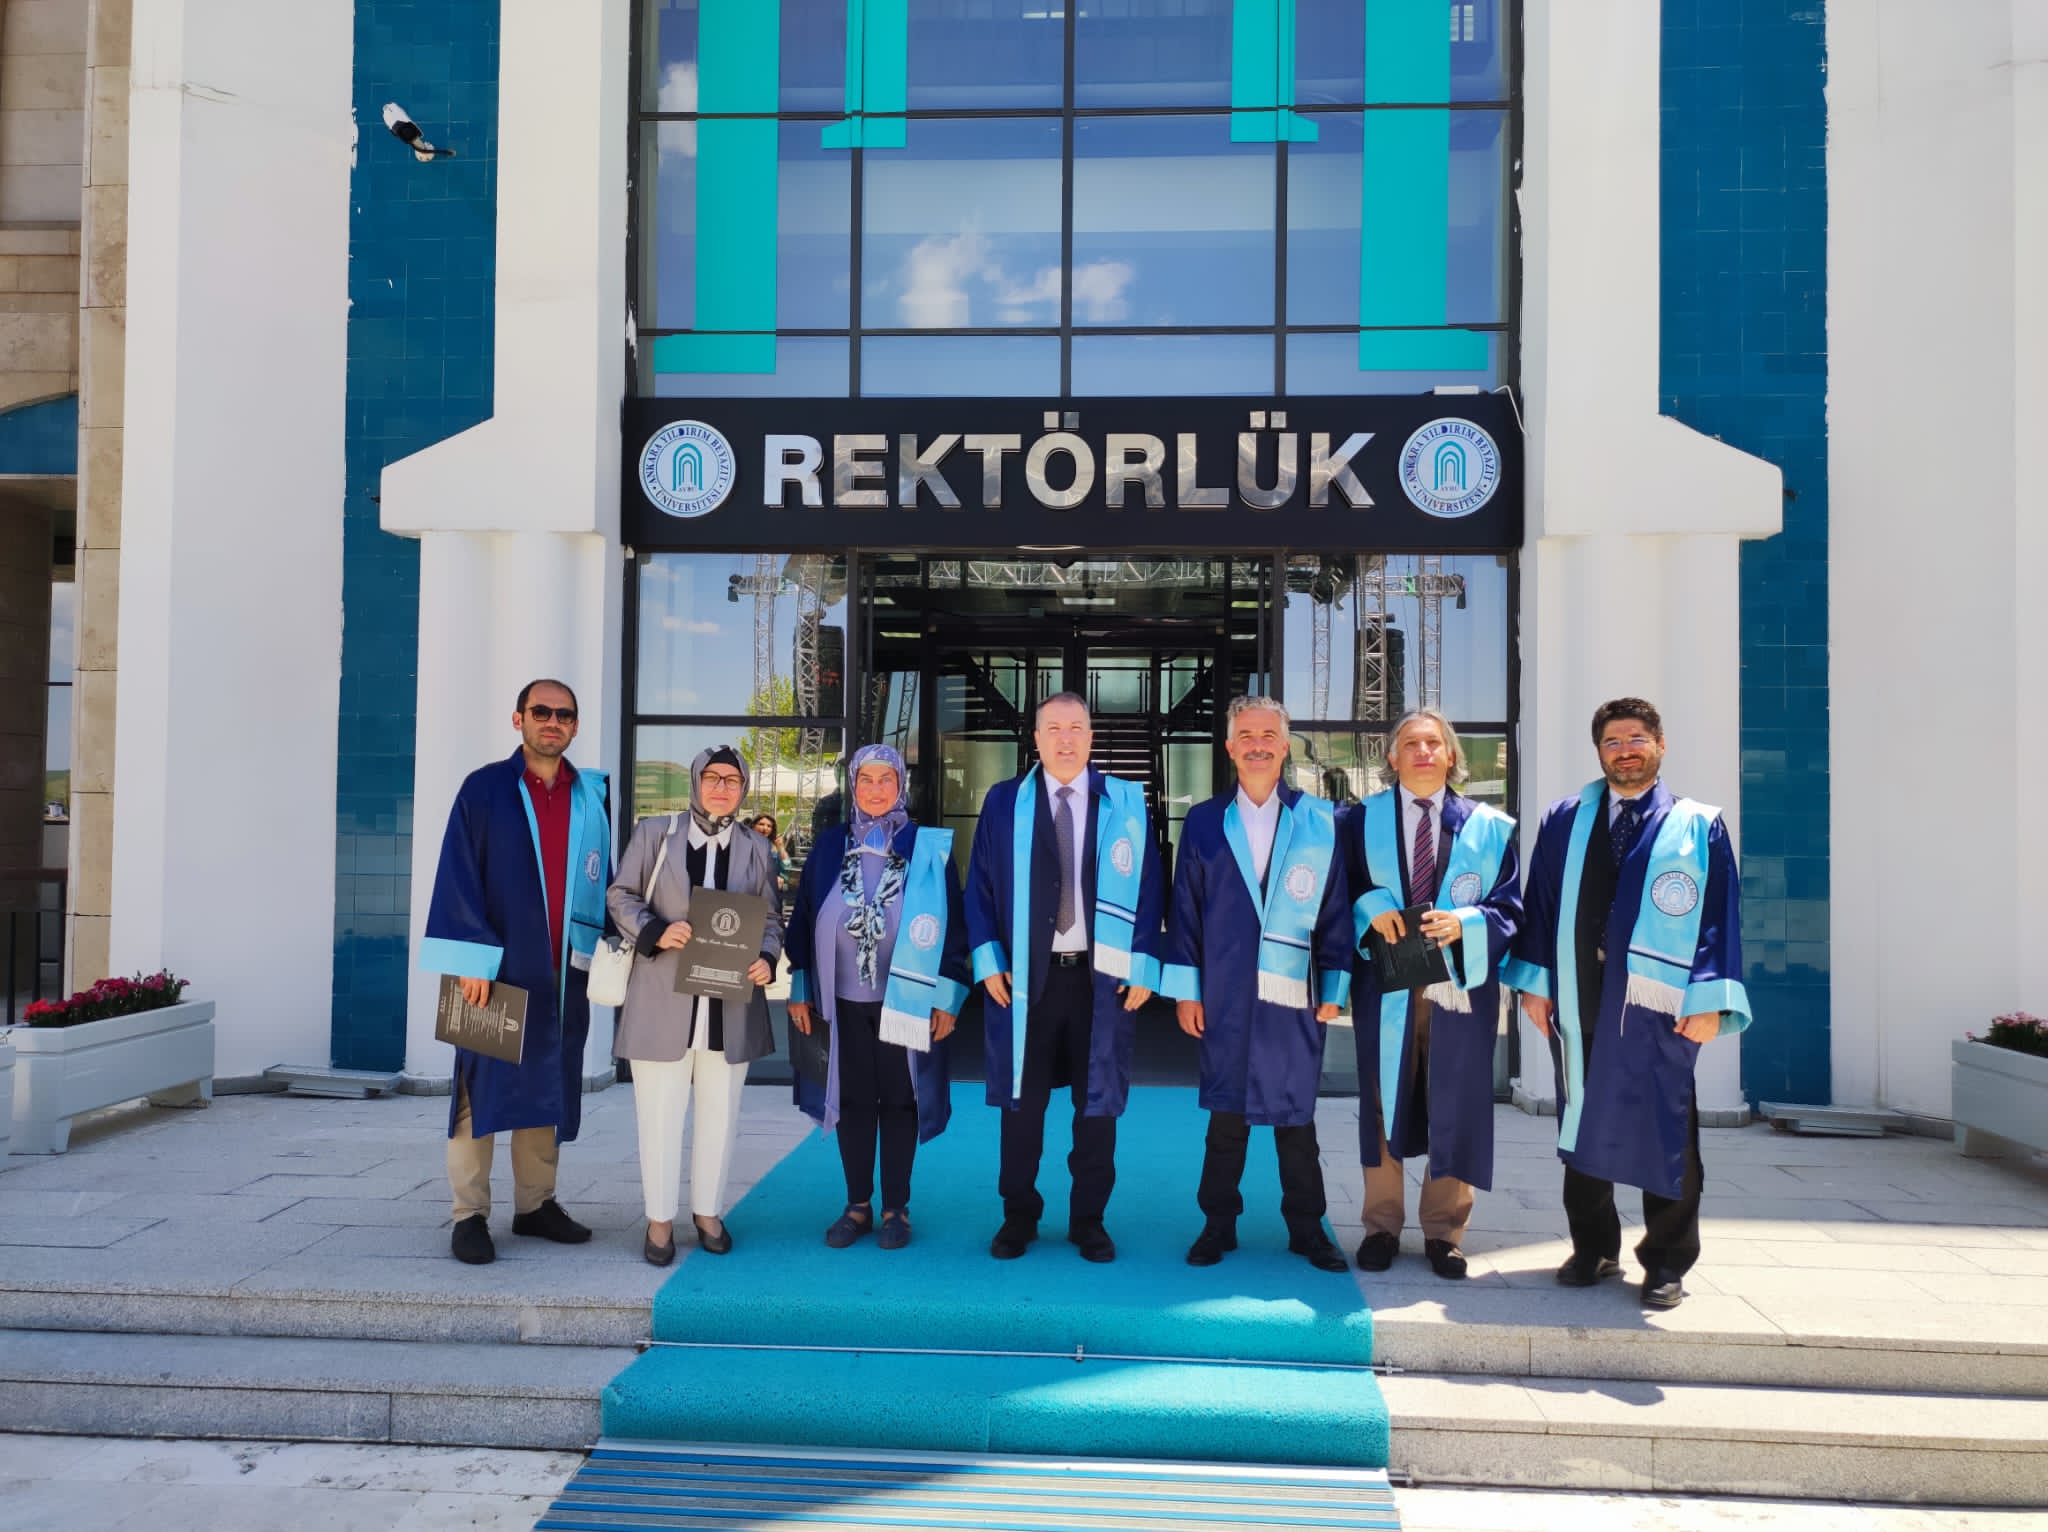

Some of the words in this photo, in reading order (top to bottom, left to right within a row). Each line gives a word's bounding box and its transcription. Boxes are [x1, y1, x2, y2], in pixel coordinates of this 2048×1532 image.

[645, 443, 662, 484] ANKARA
[660, 427, 711, 444] YILDIRIM
[711, 439, 729, 481] BEYAZIT
[763, 410, 1377, 510] REKTÖRLÜK
[1406, 441, 1424, 482] ANKARA
[1421, 424, 1477, 441] YILDIRIM
[1475, 437, 1495, 482] BEYAZIT
